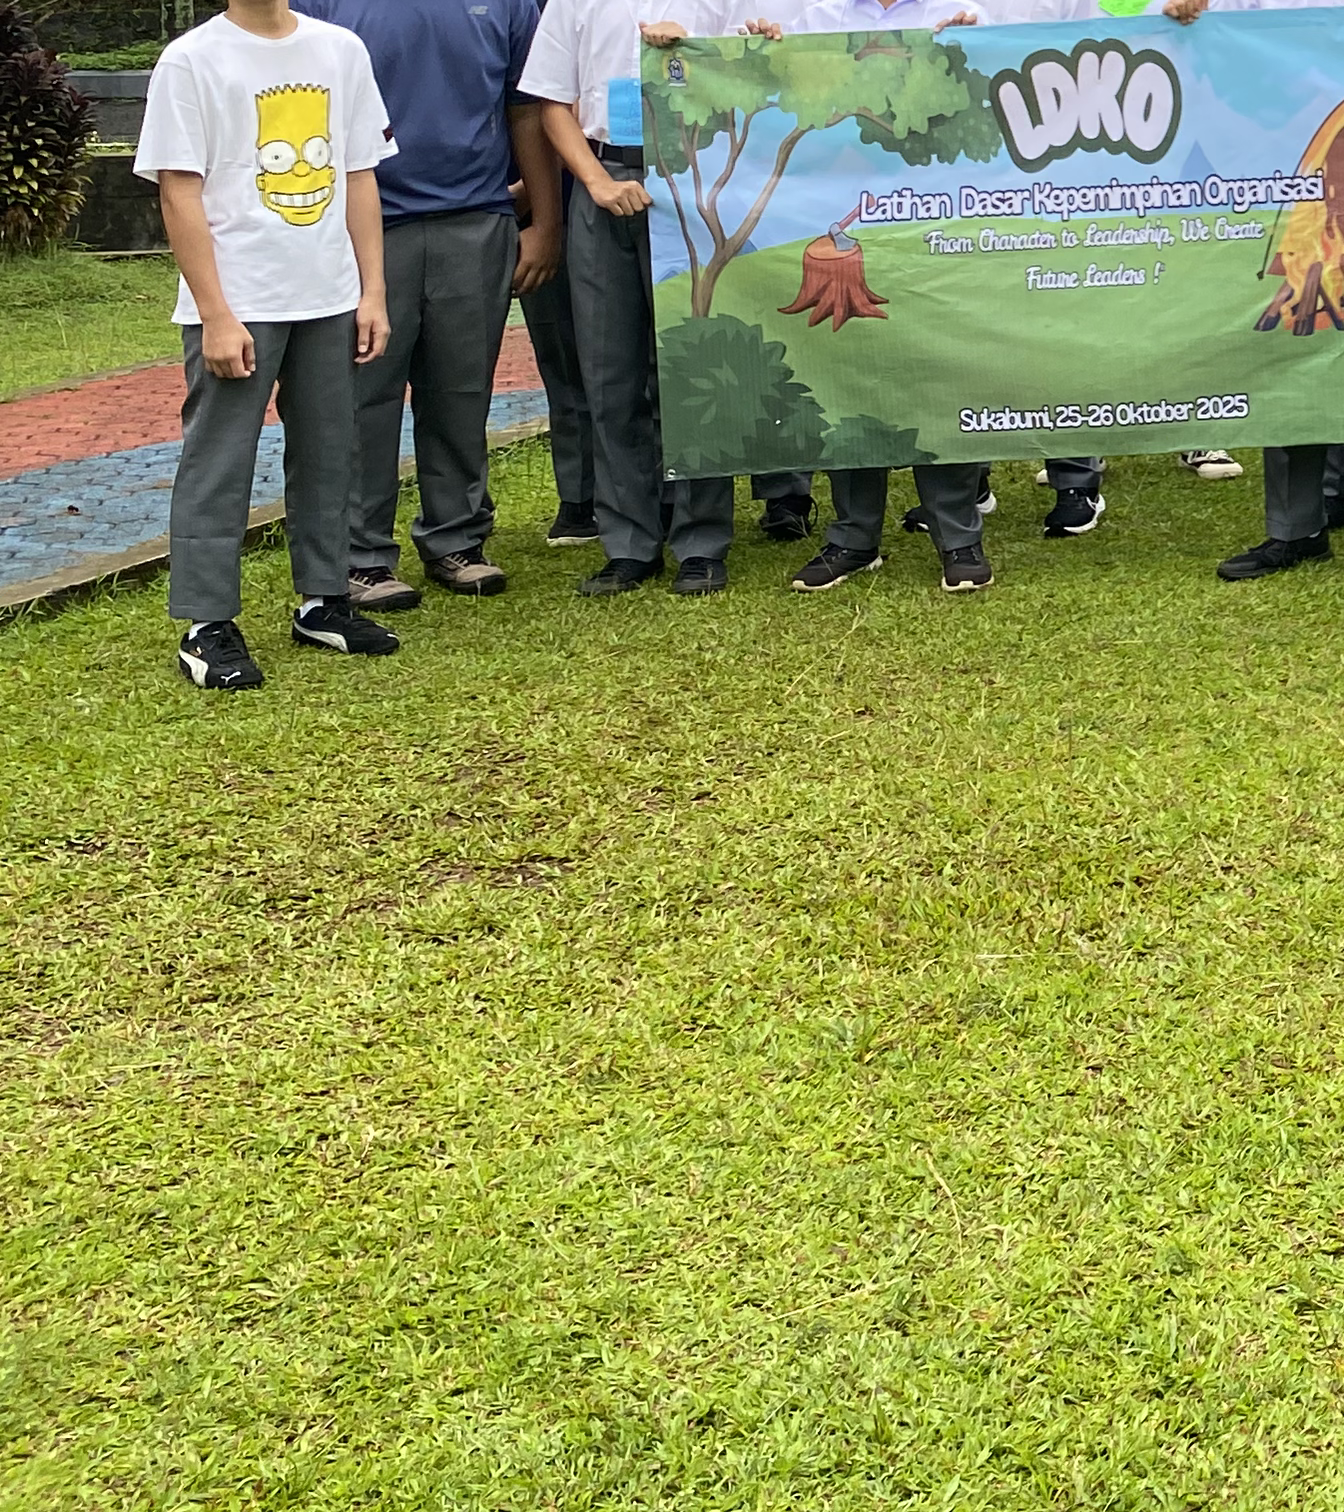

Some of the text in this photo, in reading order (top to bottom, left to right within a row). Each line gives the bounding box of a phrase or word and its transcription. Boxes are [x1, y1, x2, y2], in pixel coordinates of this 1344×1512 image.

[998, 50, 1174, 160] LDKO
[860, 170, 1325, 222] Latihan Dasar Kepemimpinan Organisasi
[978, 227, 1057, 252] Character
[1061, 229, 1079, 248] to
[1083, 222, 1175, 250] Leadership,
[1180, 219, 1210, 242] We
[1215, 217, 1265, 240] Create
[1026, 265, 1079, 290] Future
[1083, 262, 1146, 288] Leaders
[960, 394, 1249, 432] Sukabumi, 25-26 Oktober 2025
